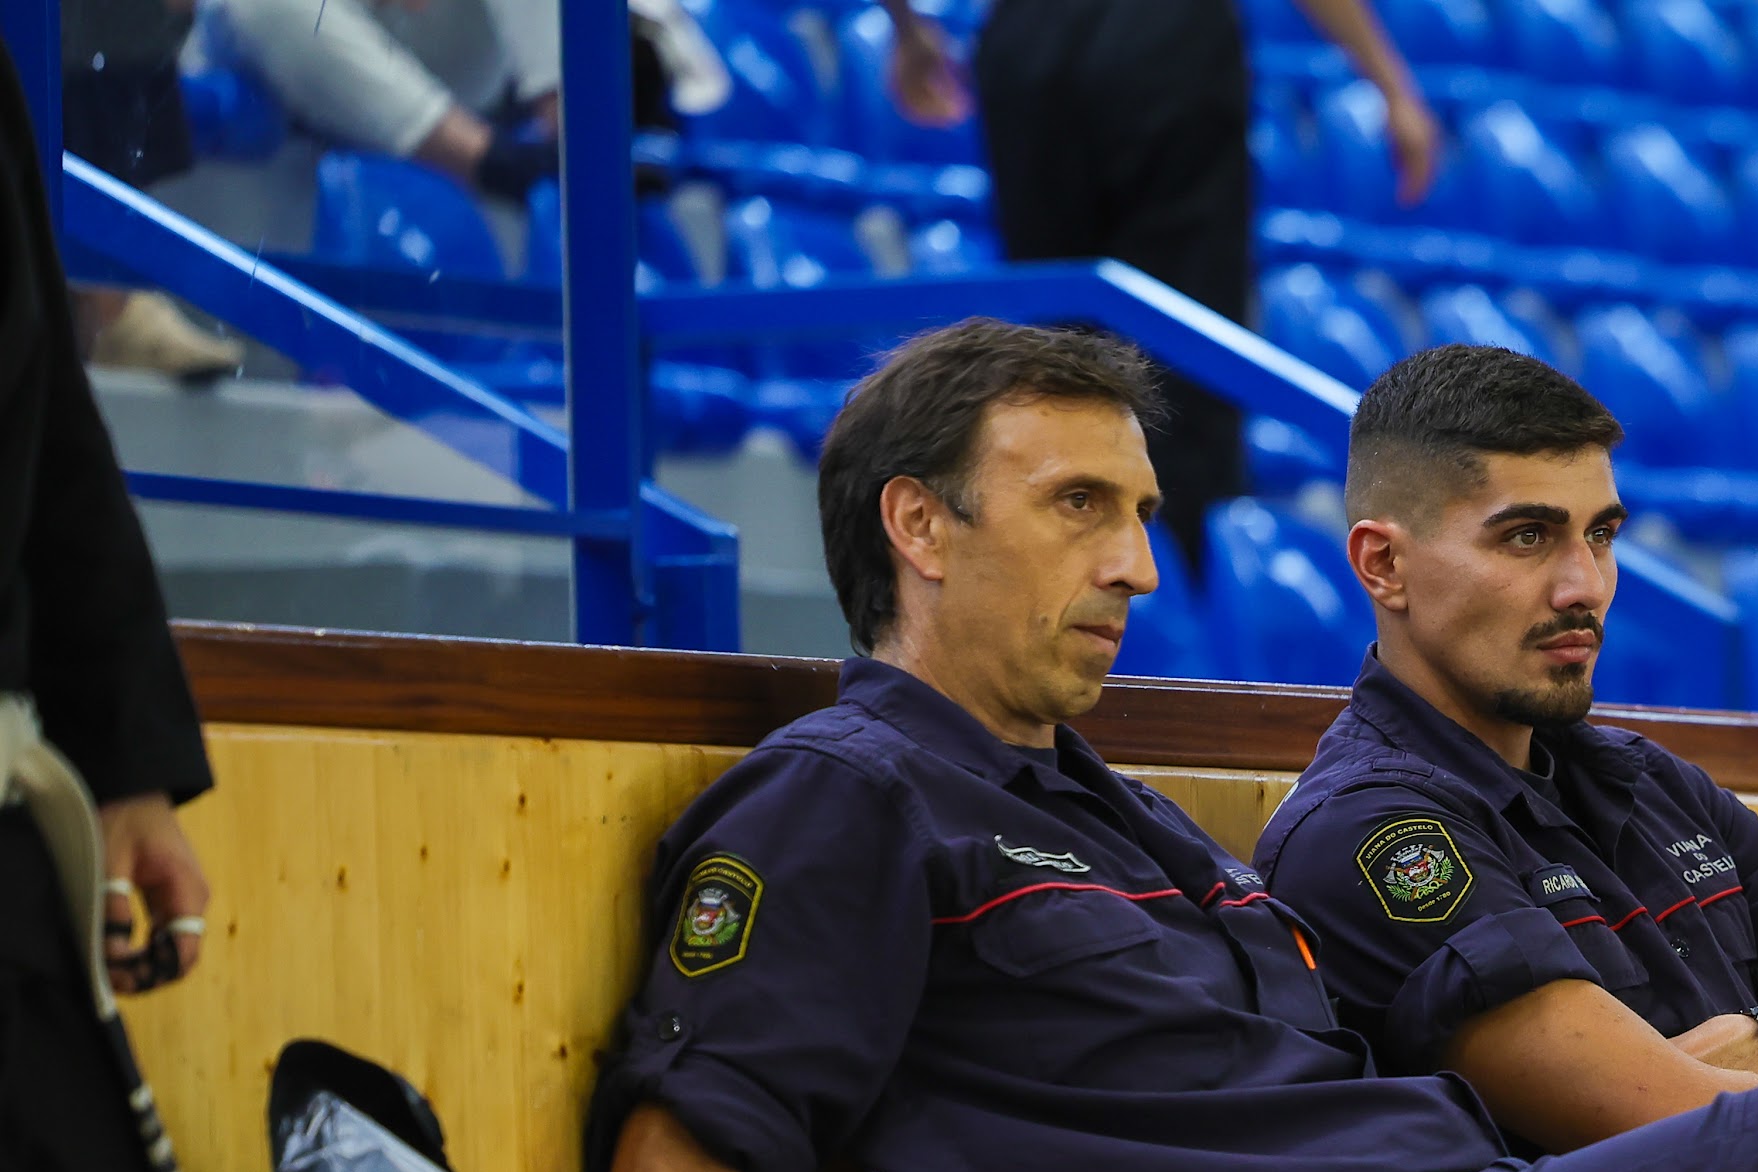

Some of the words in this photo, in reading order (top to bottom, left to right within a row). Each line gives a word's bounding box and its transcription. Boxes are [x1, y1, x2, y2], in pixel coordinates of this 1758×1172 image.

[1365, 839, 1386, 860] VIANA
[1385, 832, 1397, 841] DO
[1397, 824, 1434, 835] CASTELO
[1665, 833, 1712, 857] VIANA
[1682, 855, 1736, 884] CASTEL
